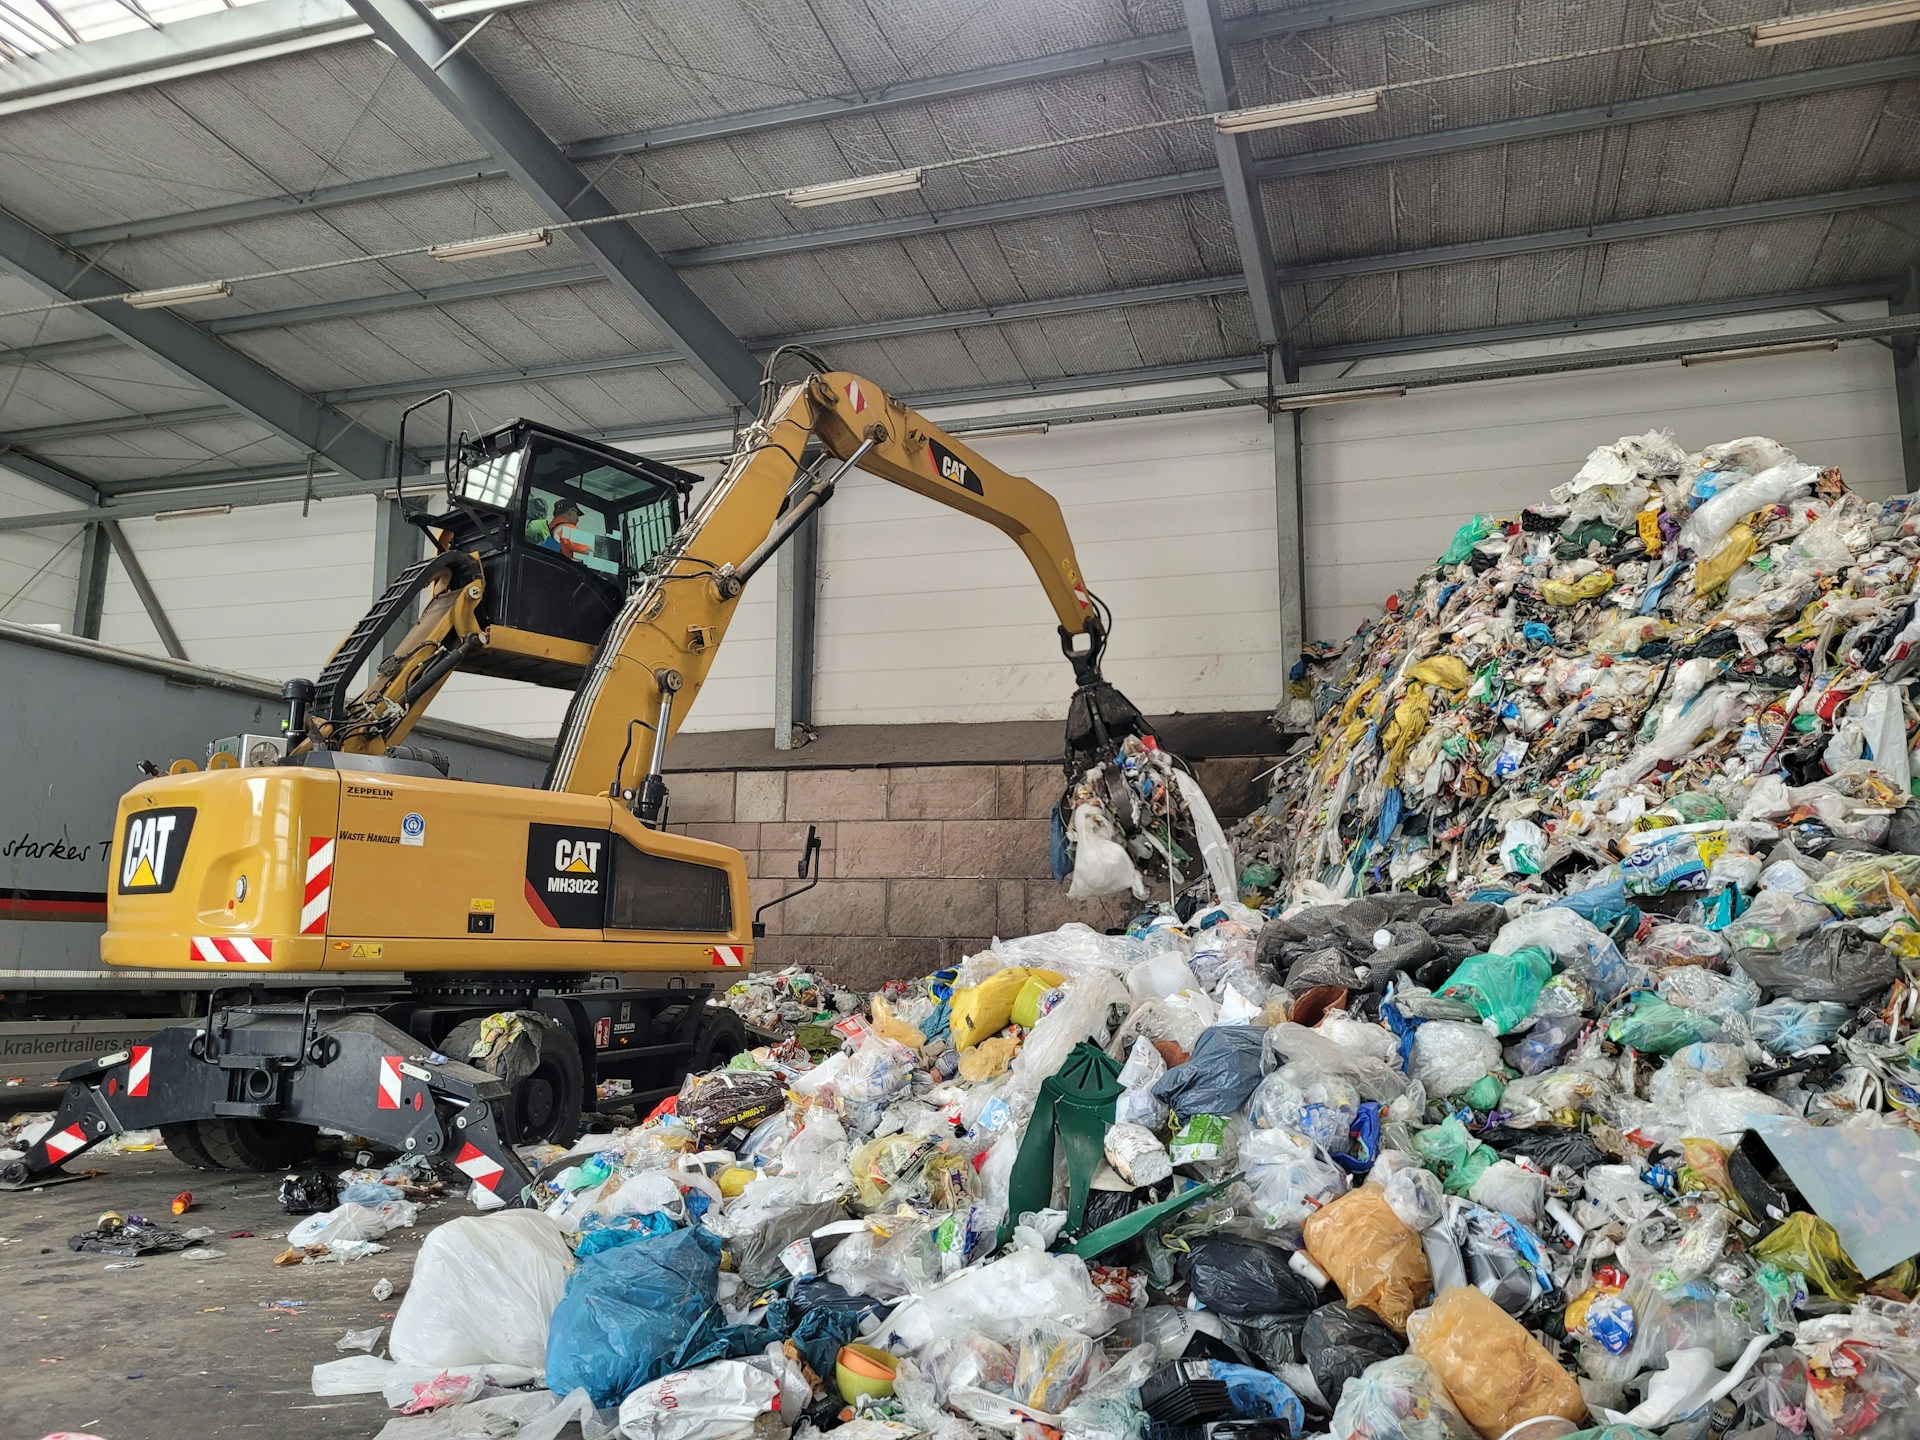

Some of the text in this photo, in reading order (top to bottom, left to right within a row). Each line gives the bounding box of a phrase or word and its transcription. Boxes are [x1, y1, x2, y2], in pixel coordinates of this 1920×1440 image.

[942, 455, 967, 485] CAT
[347, 786, 393, 796] ZEPPELIN
[3, 832, 91, 861] starkes
[123, 815, 176, 887] CAT
[555, 839, 601, 873] CAT
[547, 876, 599, 894] MH3022
[613, 1022, 636, 1031] ZEPPELIN
[737, 1106, 761, 1121] COMPO
